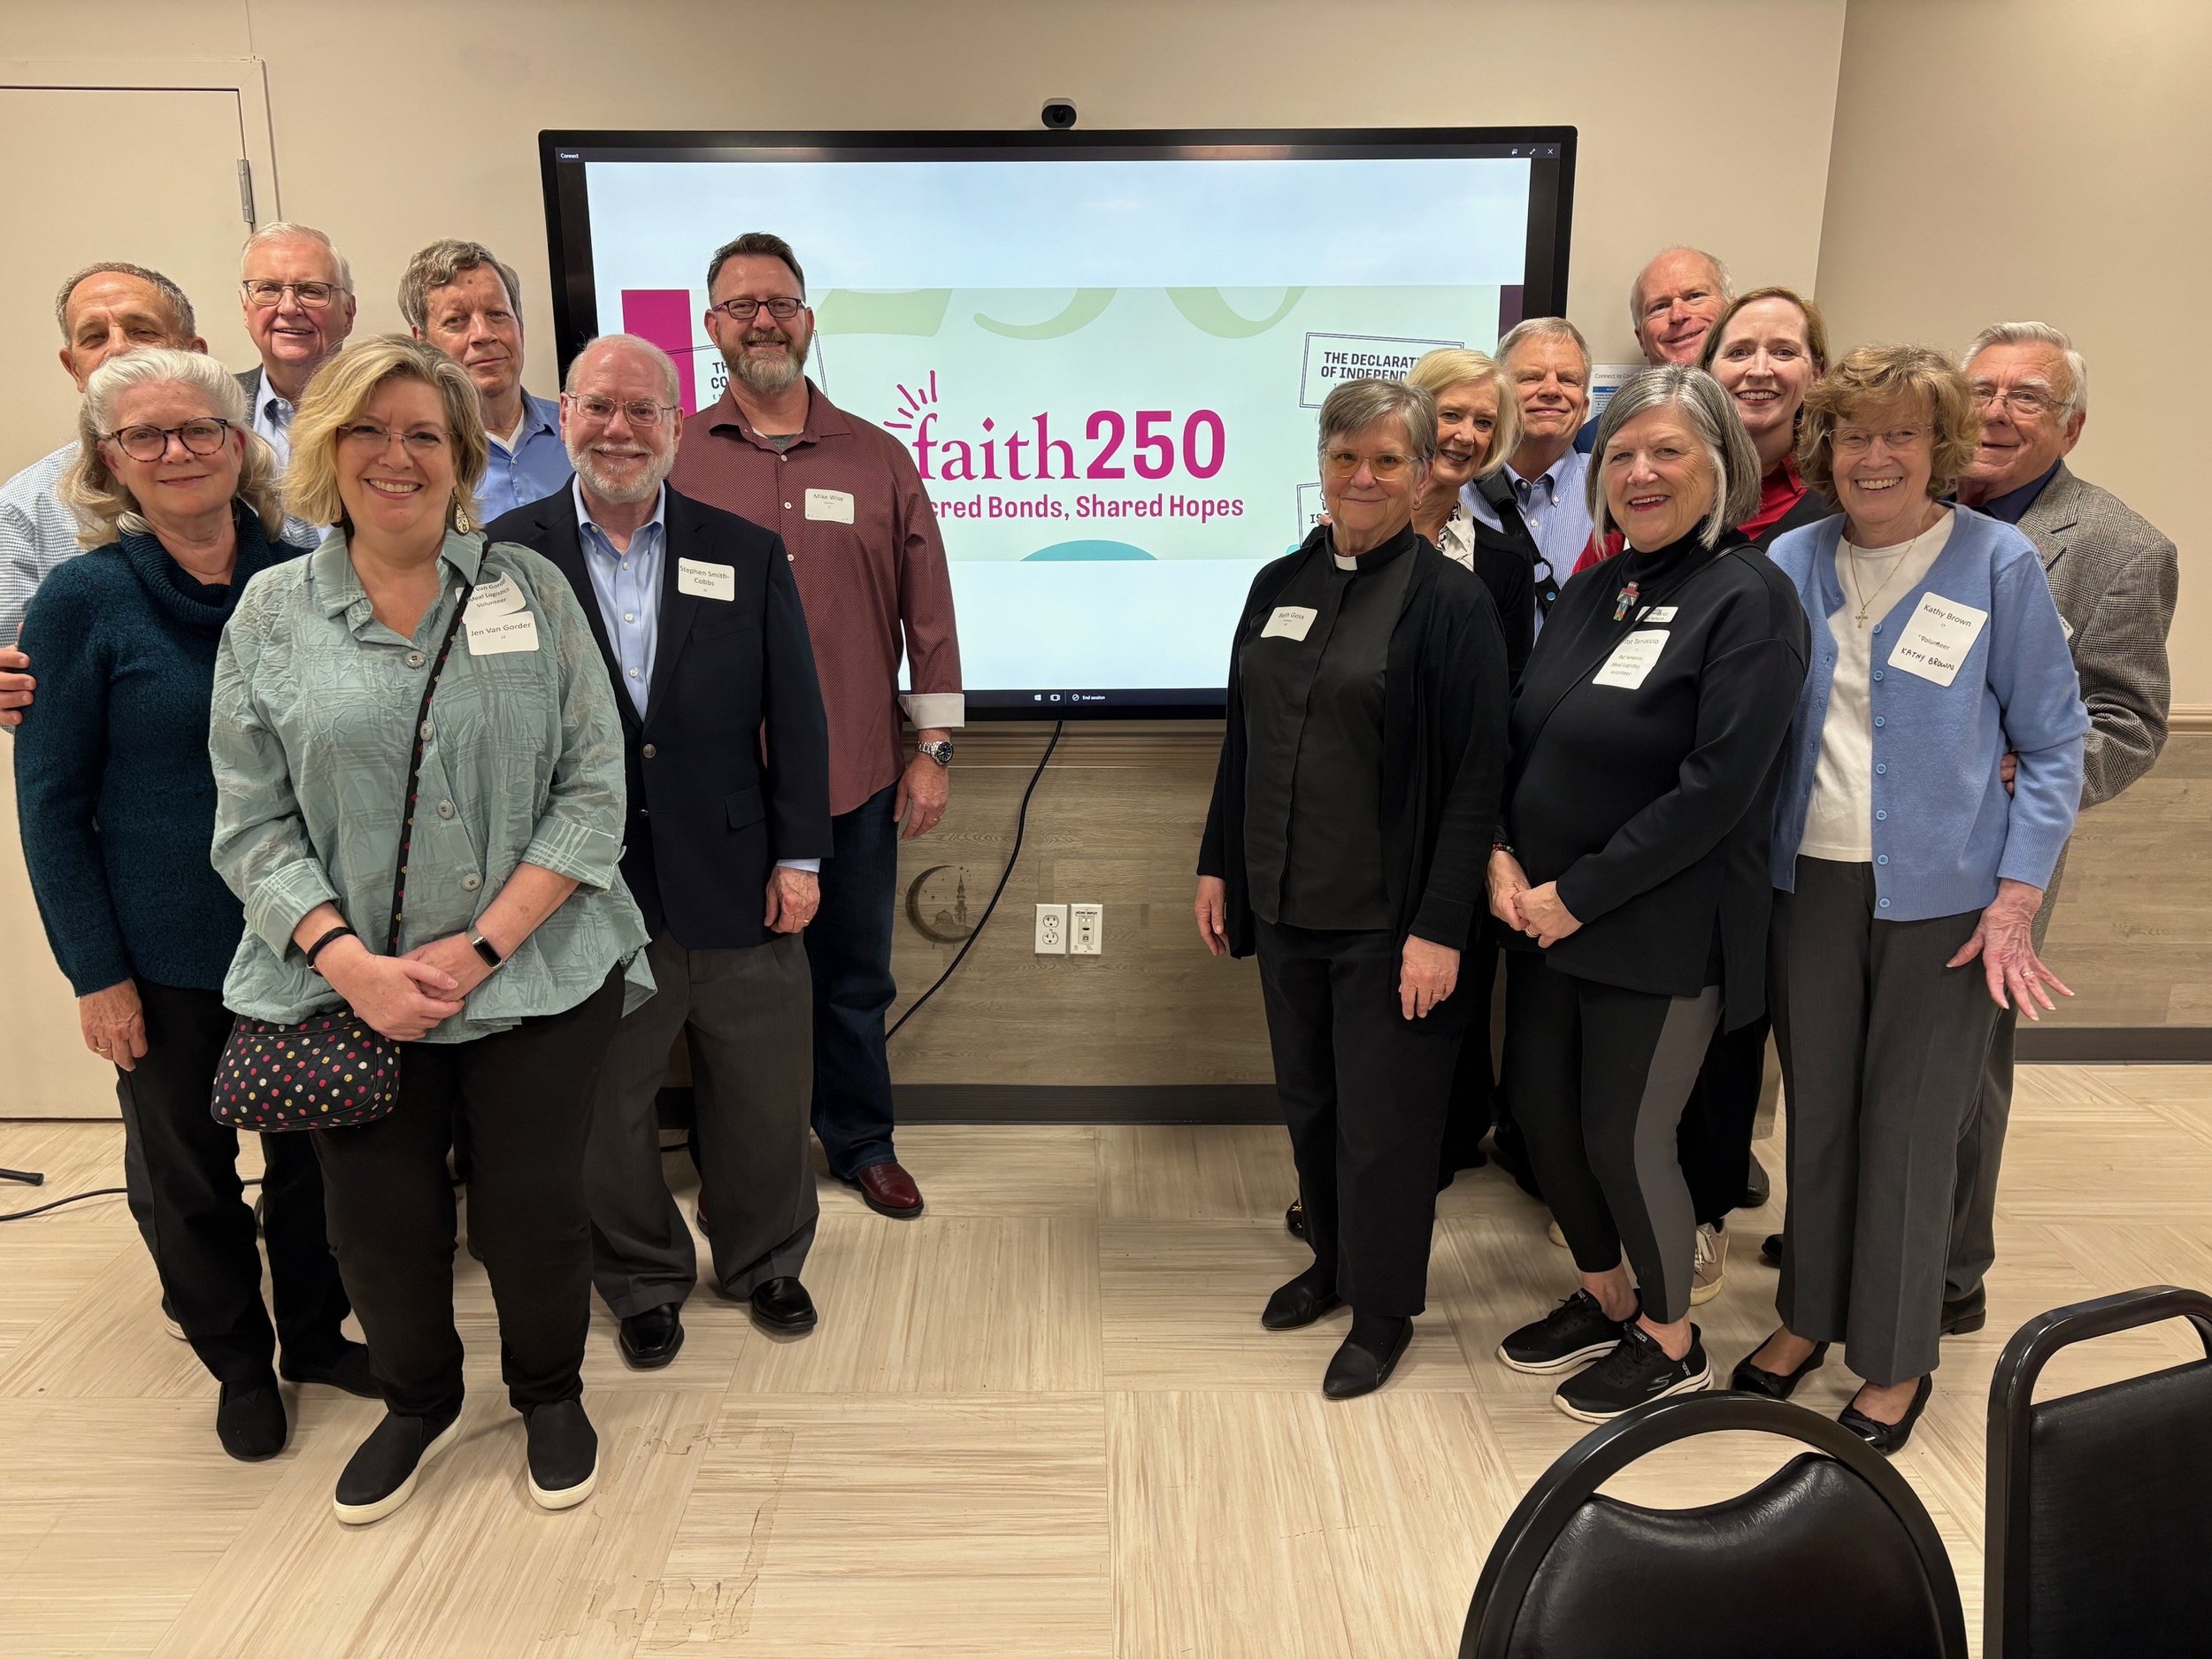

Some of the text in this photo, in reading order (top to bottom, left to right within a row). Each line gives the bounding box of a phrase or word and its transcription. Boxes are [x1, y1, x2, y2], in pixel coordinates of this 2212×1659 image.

[1324, 352, 1419, 368] THE DECLARAT
[1321, 365, 1337, 378] OF
[988, 495, 1070, 520] Bonds,
[1076, 494, 1163, 518] Shared
[1169, 495, 1244, 524] Hopes
[680, 565, 730, 580] Stephen Smith-
[694, 577, 715, 587] Cobbs
[476, 597, 507, 608] Volunteer
[1924, 603, 1972, 627] Kathy Brown
[503, 622, 532, 631] Gorder
[1901, 647, 1955, 671] KATHY BROWN
